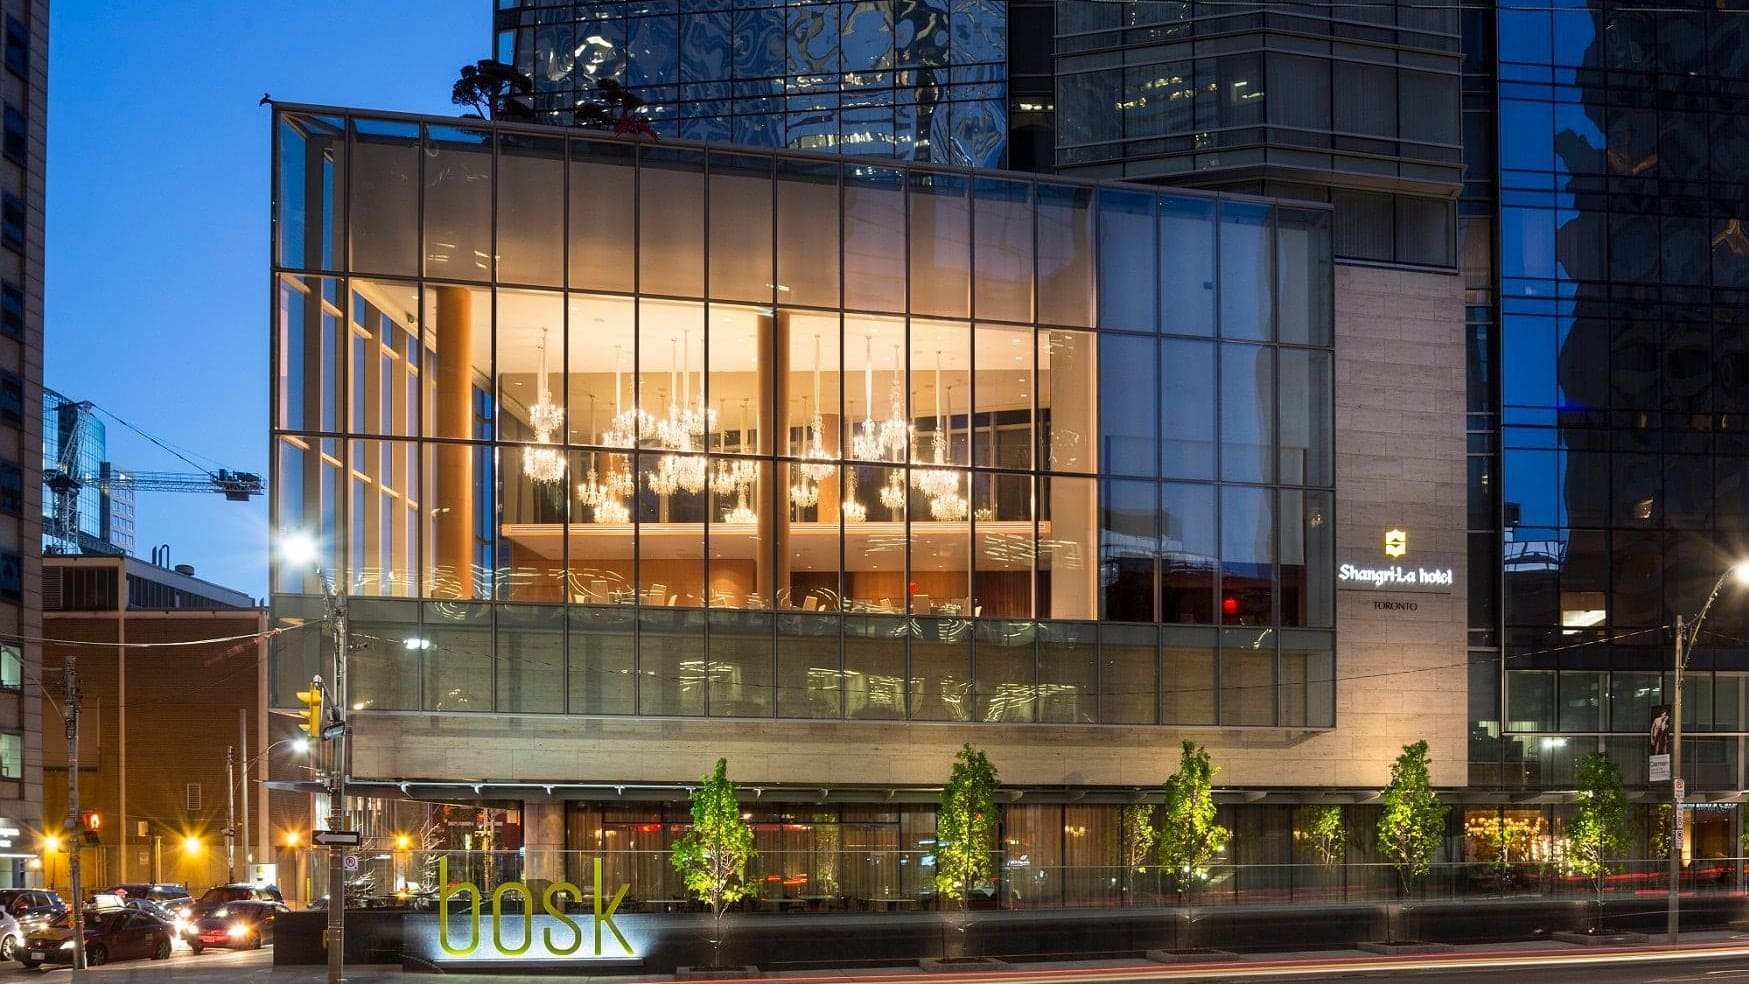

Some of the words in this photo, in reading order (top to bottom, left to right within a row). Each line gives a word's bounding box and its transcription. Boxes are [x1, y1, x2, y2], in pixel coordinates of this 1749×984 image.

[1338, 564, 1416, 586] Shangri-La
[1419, 567, 1453, 584] hotel
[1373, 601, 1418, 611] TORONTO
[439, 857, 635, 956] bosk
